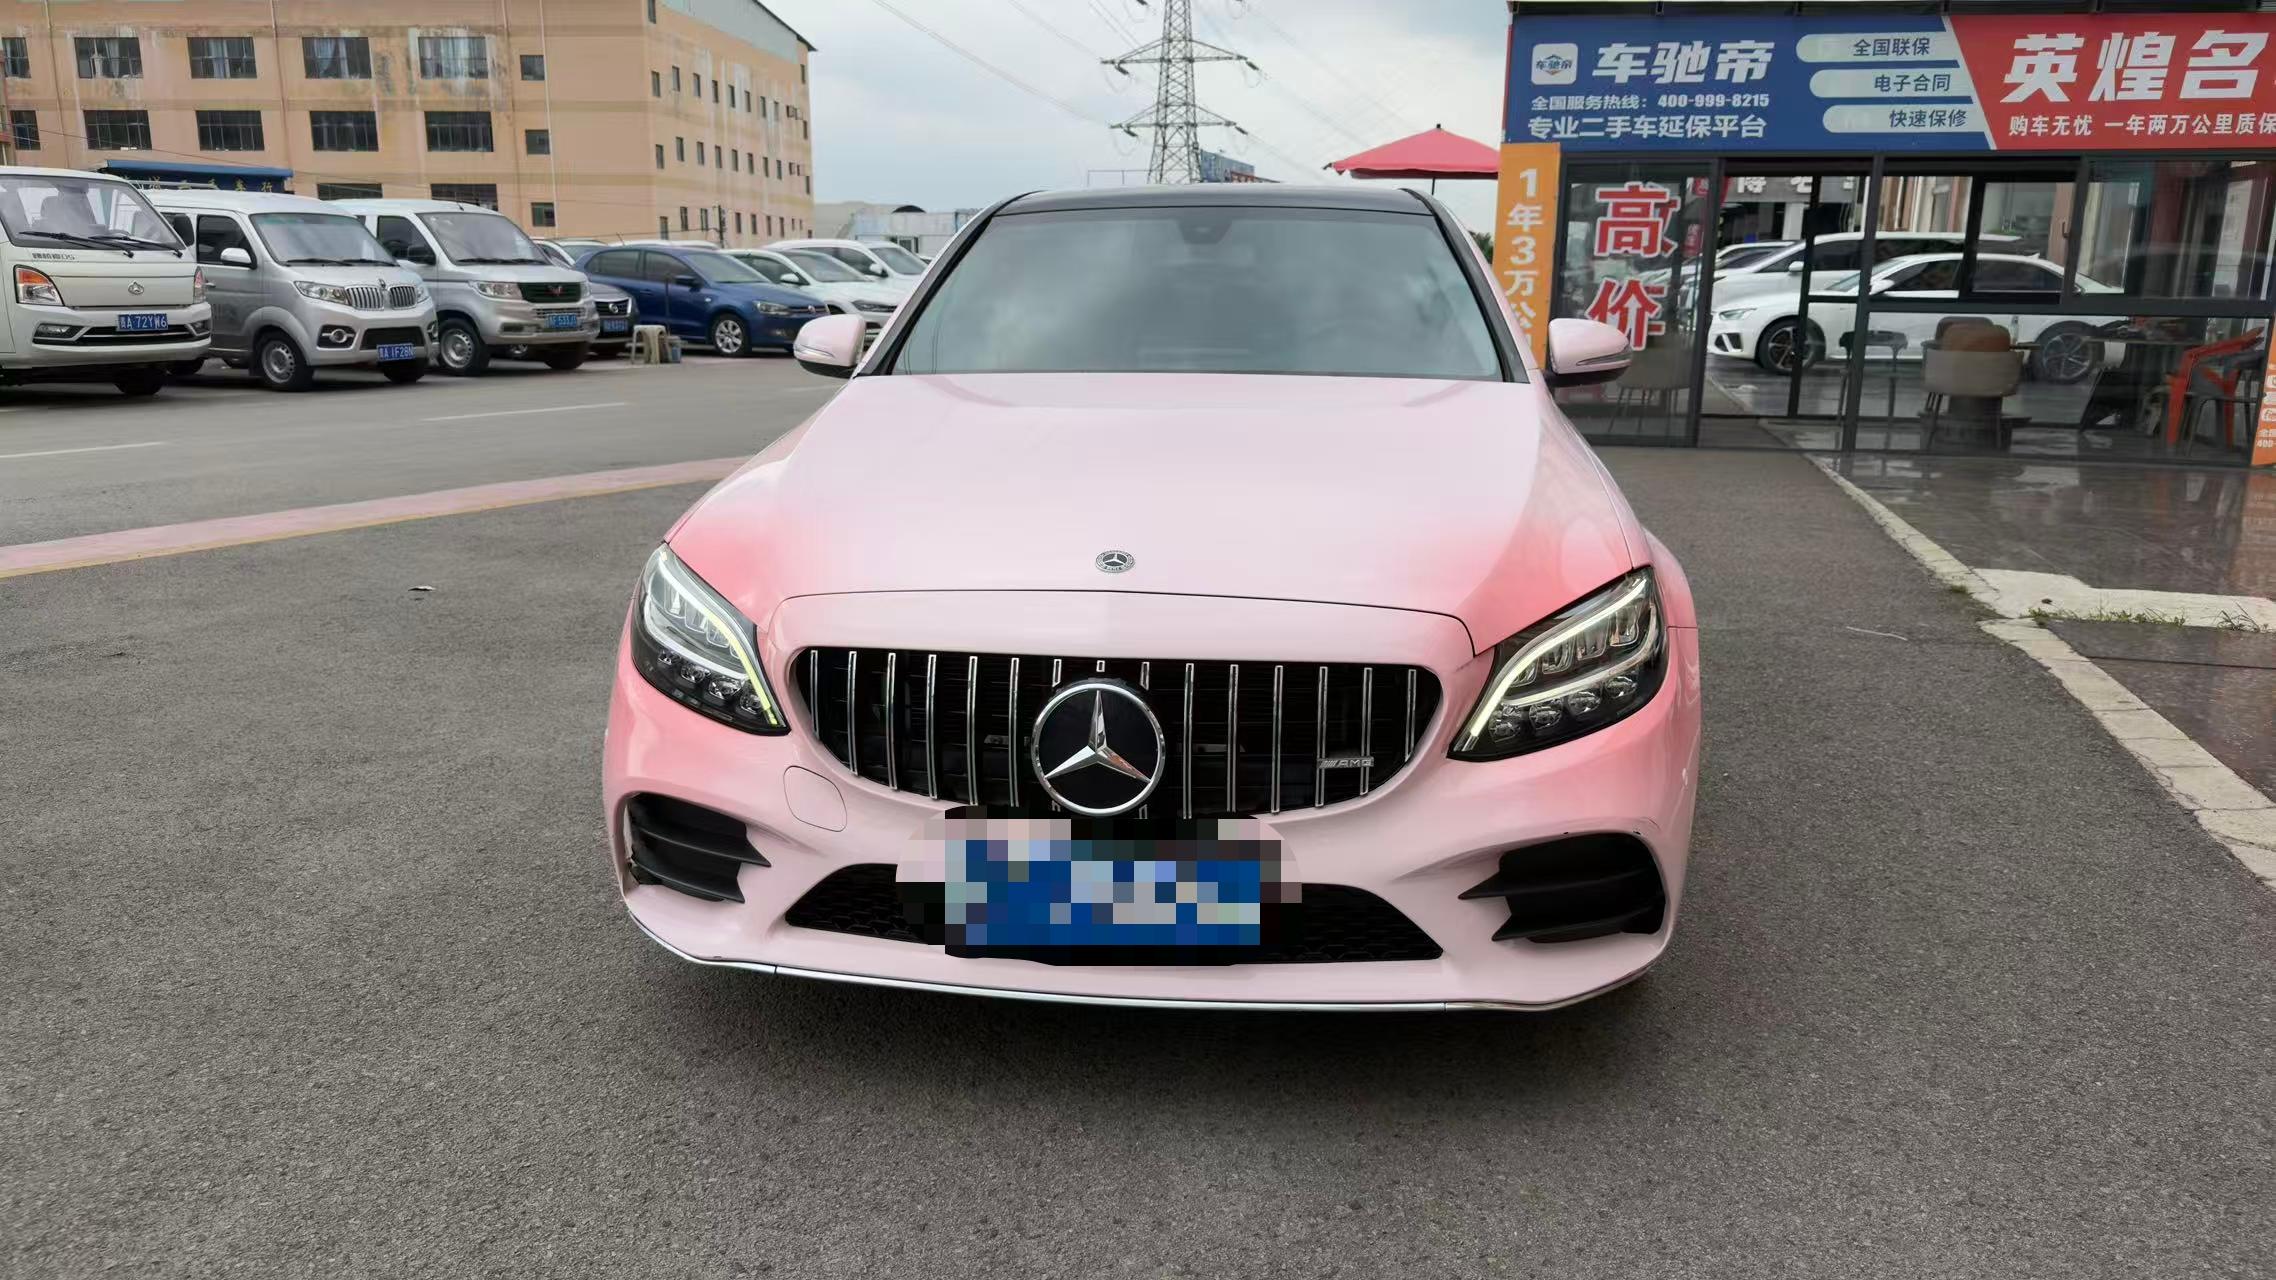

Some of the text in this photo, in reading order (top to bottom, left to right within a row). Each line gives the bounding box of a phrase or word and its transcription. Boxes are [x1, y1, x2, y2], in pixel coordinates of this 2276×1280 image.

[1853, 38, 1930, 56] 全国联保
[1592, 40, 1775, 84] 车驰帝
[2000, 30, 2269, 103] 英煌名
[1874, 74, 1951, 92] 电子合同
[1657, 94, 1770, 107] 400-999-8215
[1528, 114, 1768, 139] 专业二手车延保平台
[1889, 110, 1967, 128] 快速保修
[2008, 112, 2276, 137] 购车无忧 一年两万公里质保
